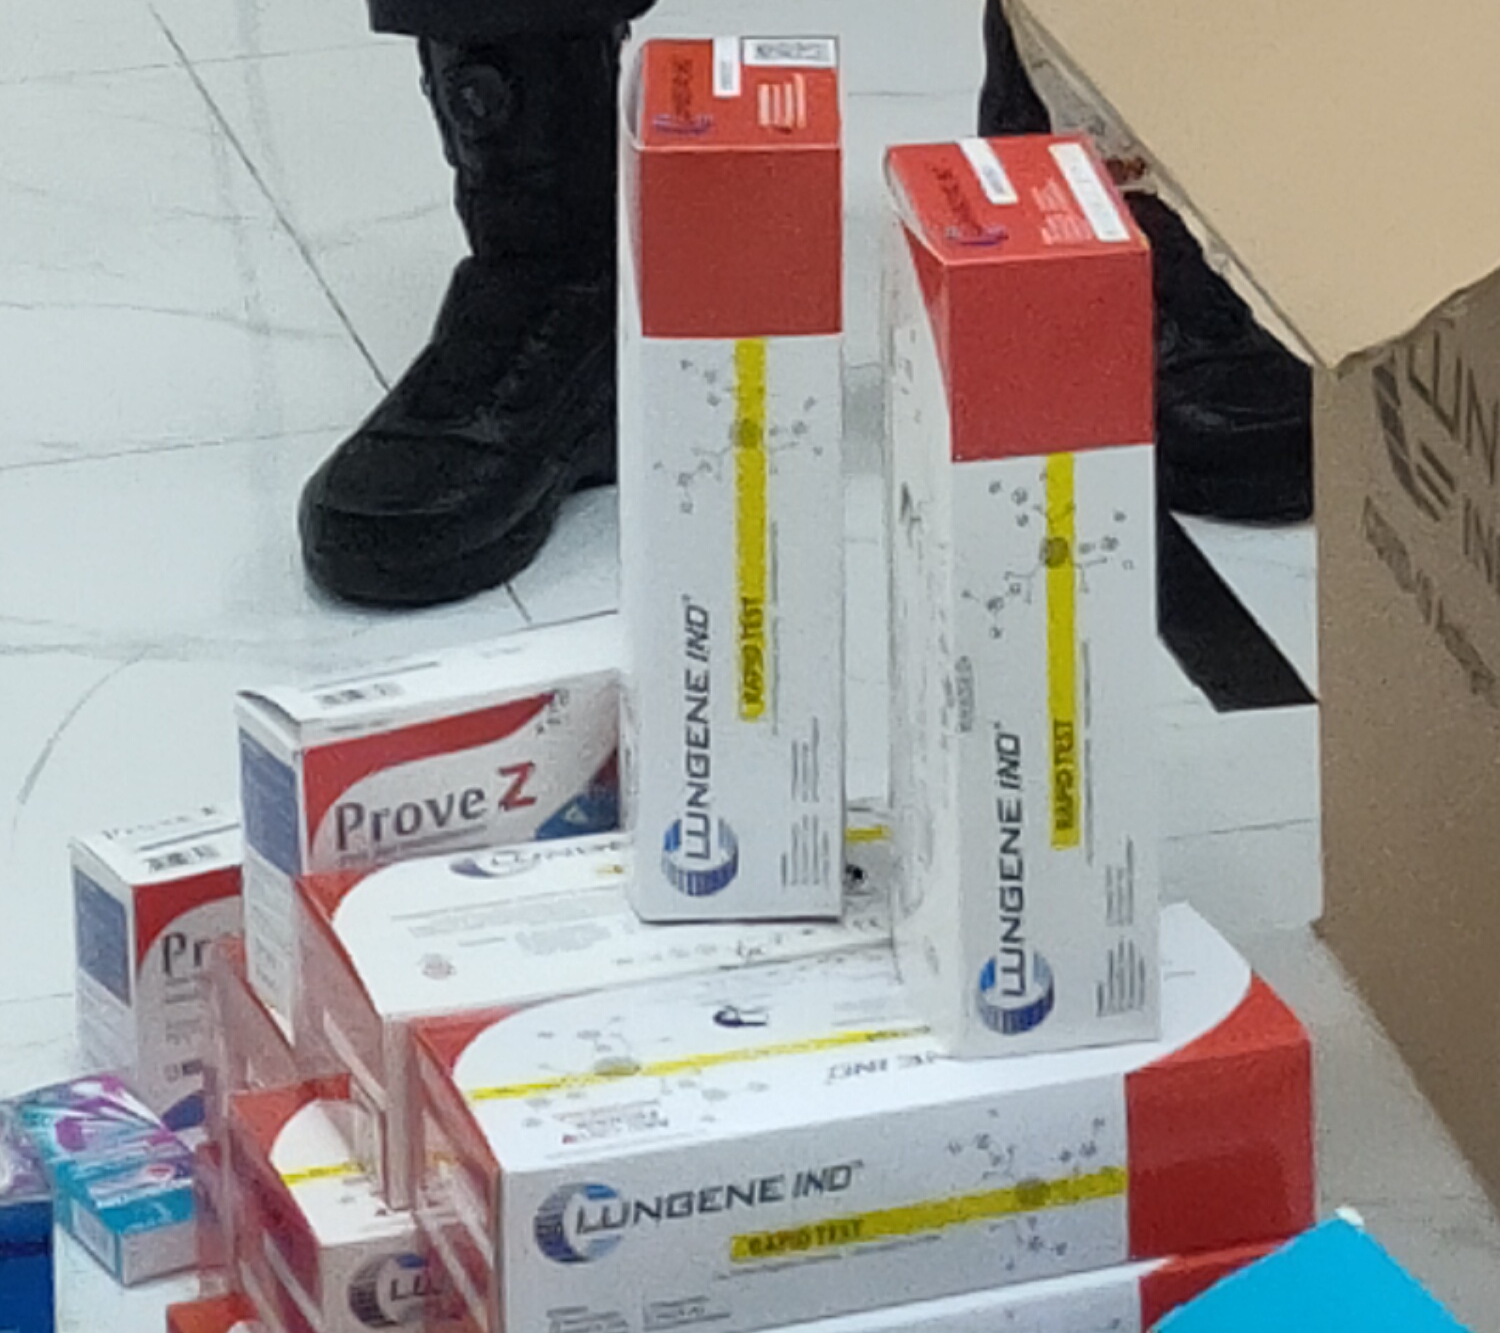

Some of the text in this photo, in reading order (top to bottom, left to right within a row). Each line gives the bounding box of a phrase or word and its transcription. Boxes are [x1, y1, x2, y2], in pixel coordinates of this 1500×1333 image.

[685, 604, 711, 860] LUNGENE IND
[996, 731, 1028, 997] LUNGENE IND
[574, 1163, 853, 1235] LUNGENE IND
[748, 1218, 865, 1257] RAPID TEST
